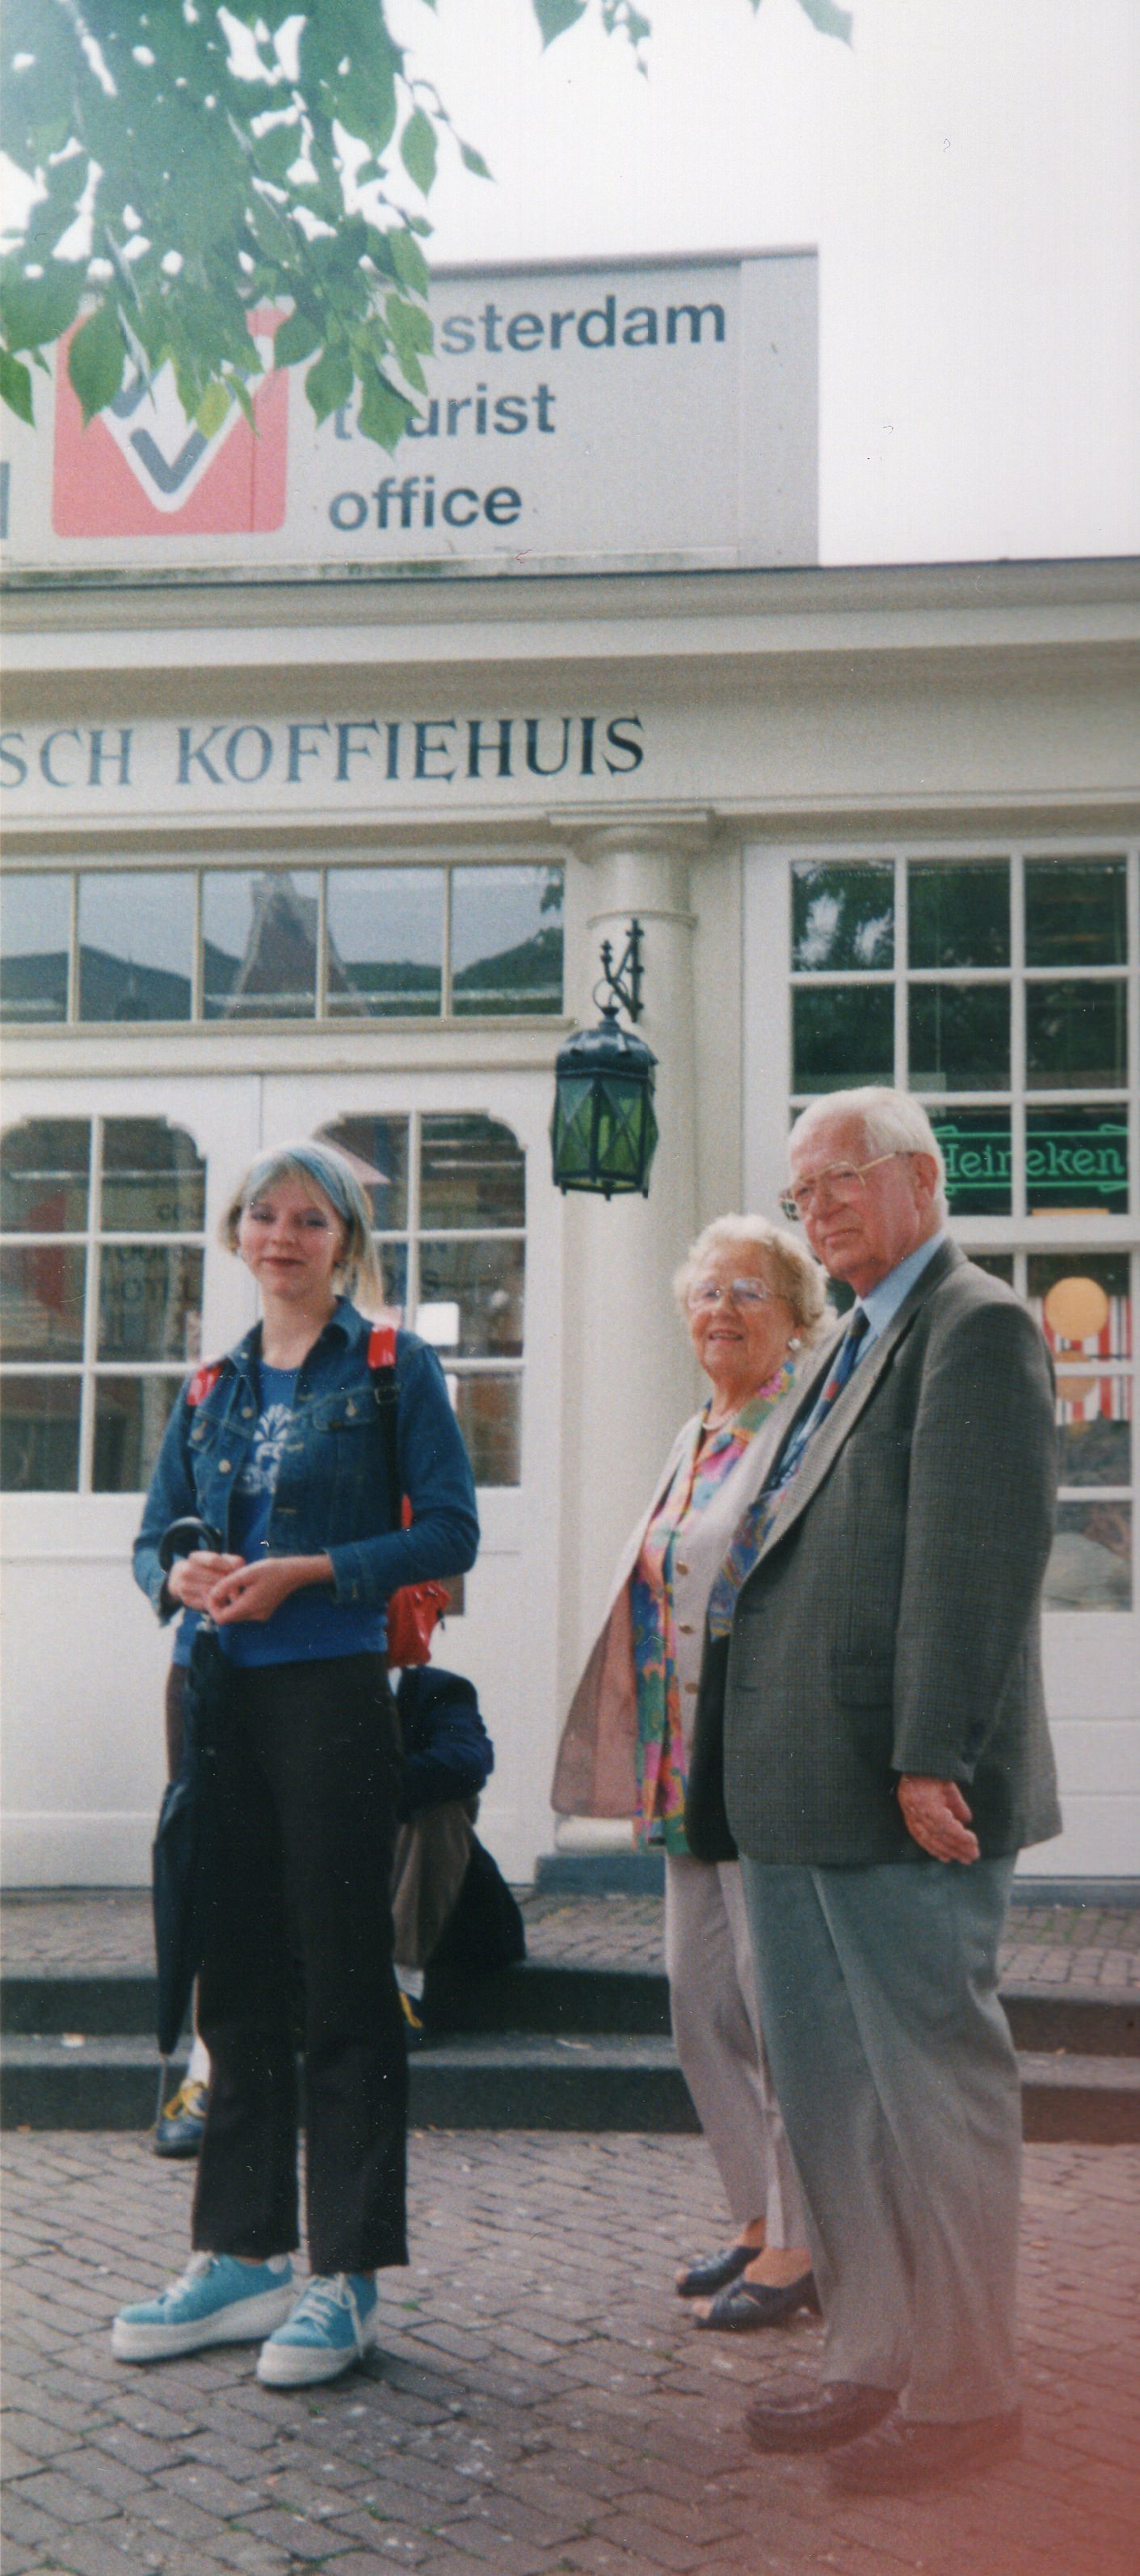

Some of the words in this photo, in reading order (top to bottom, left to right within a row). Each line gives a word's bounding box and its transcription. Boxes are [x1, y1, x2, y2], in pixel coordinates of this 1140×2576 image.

[431, 294, 726, 355] sterdam
[334, 383, 556, 441] turist
[329, 476, 522, 533] office
[175, 714, 645, 786] KOFFIEHUIS
